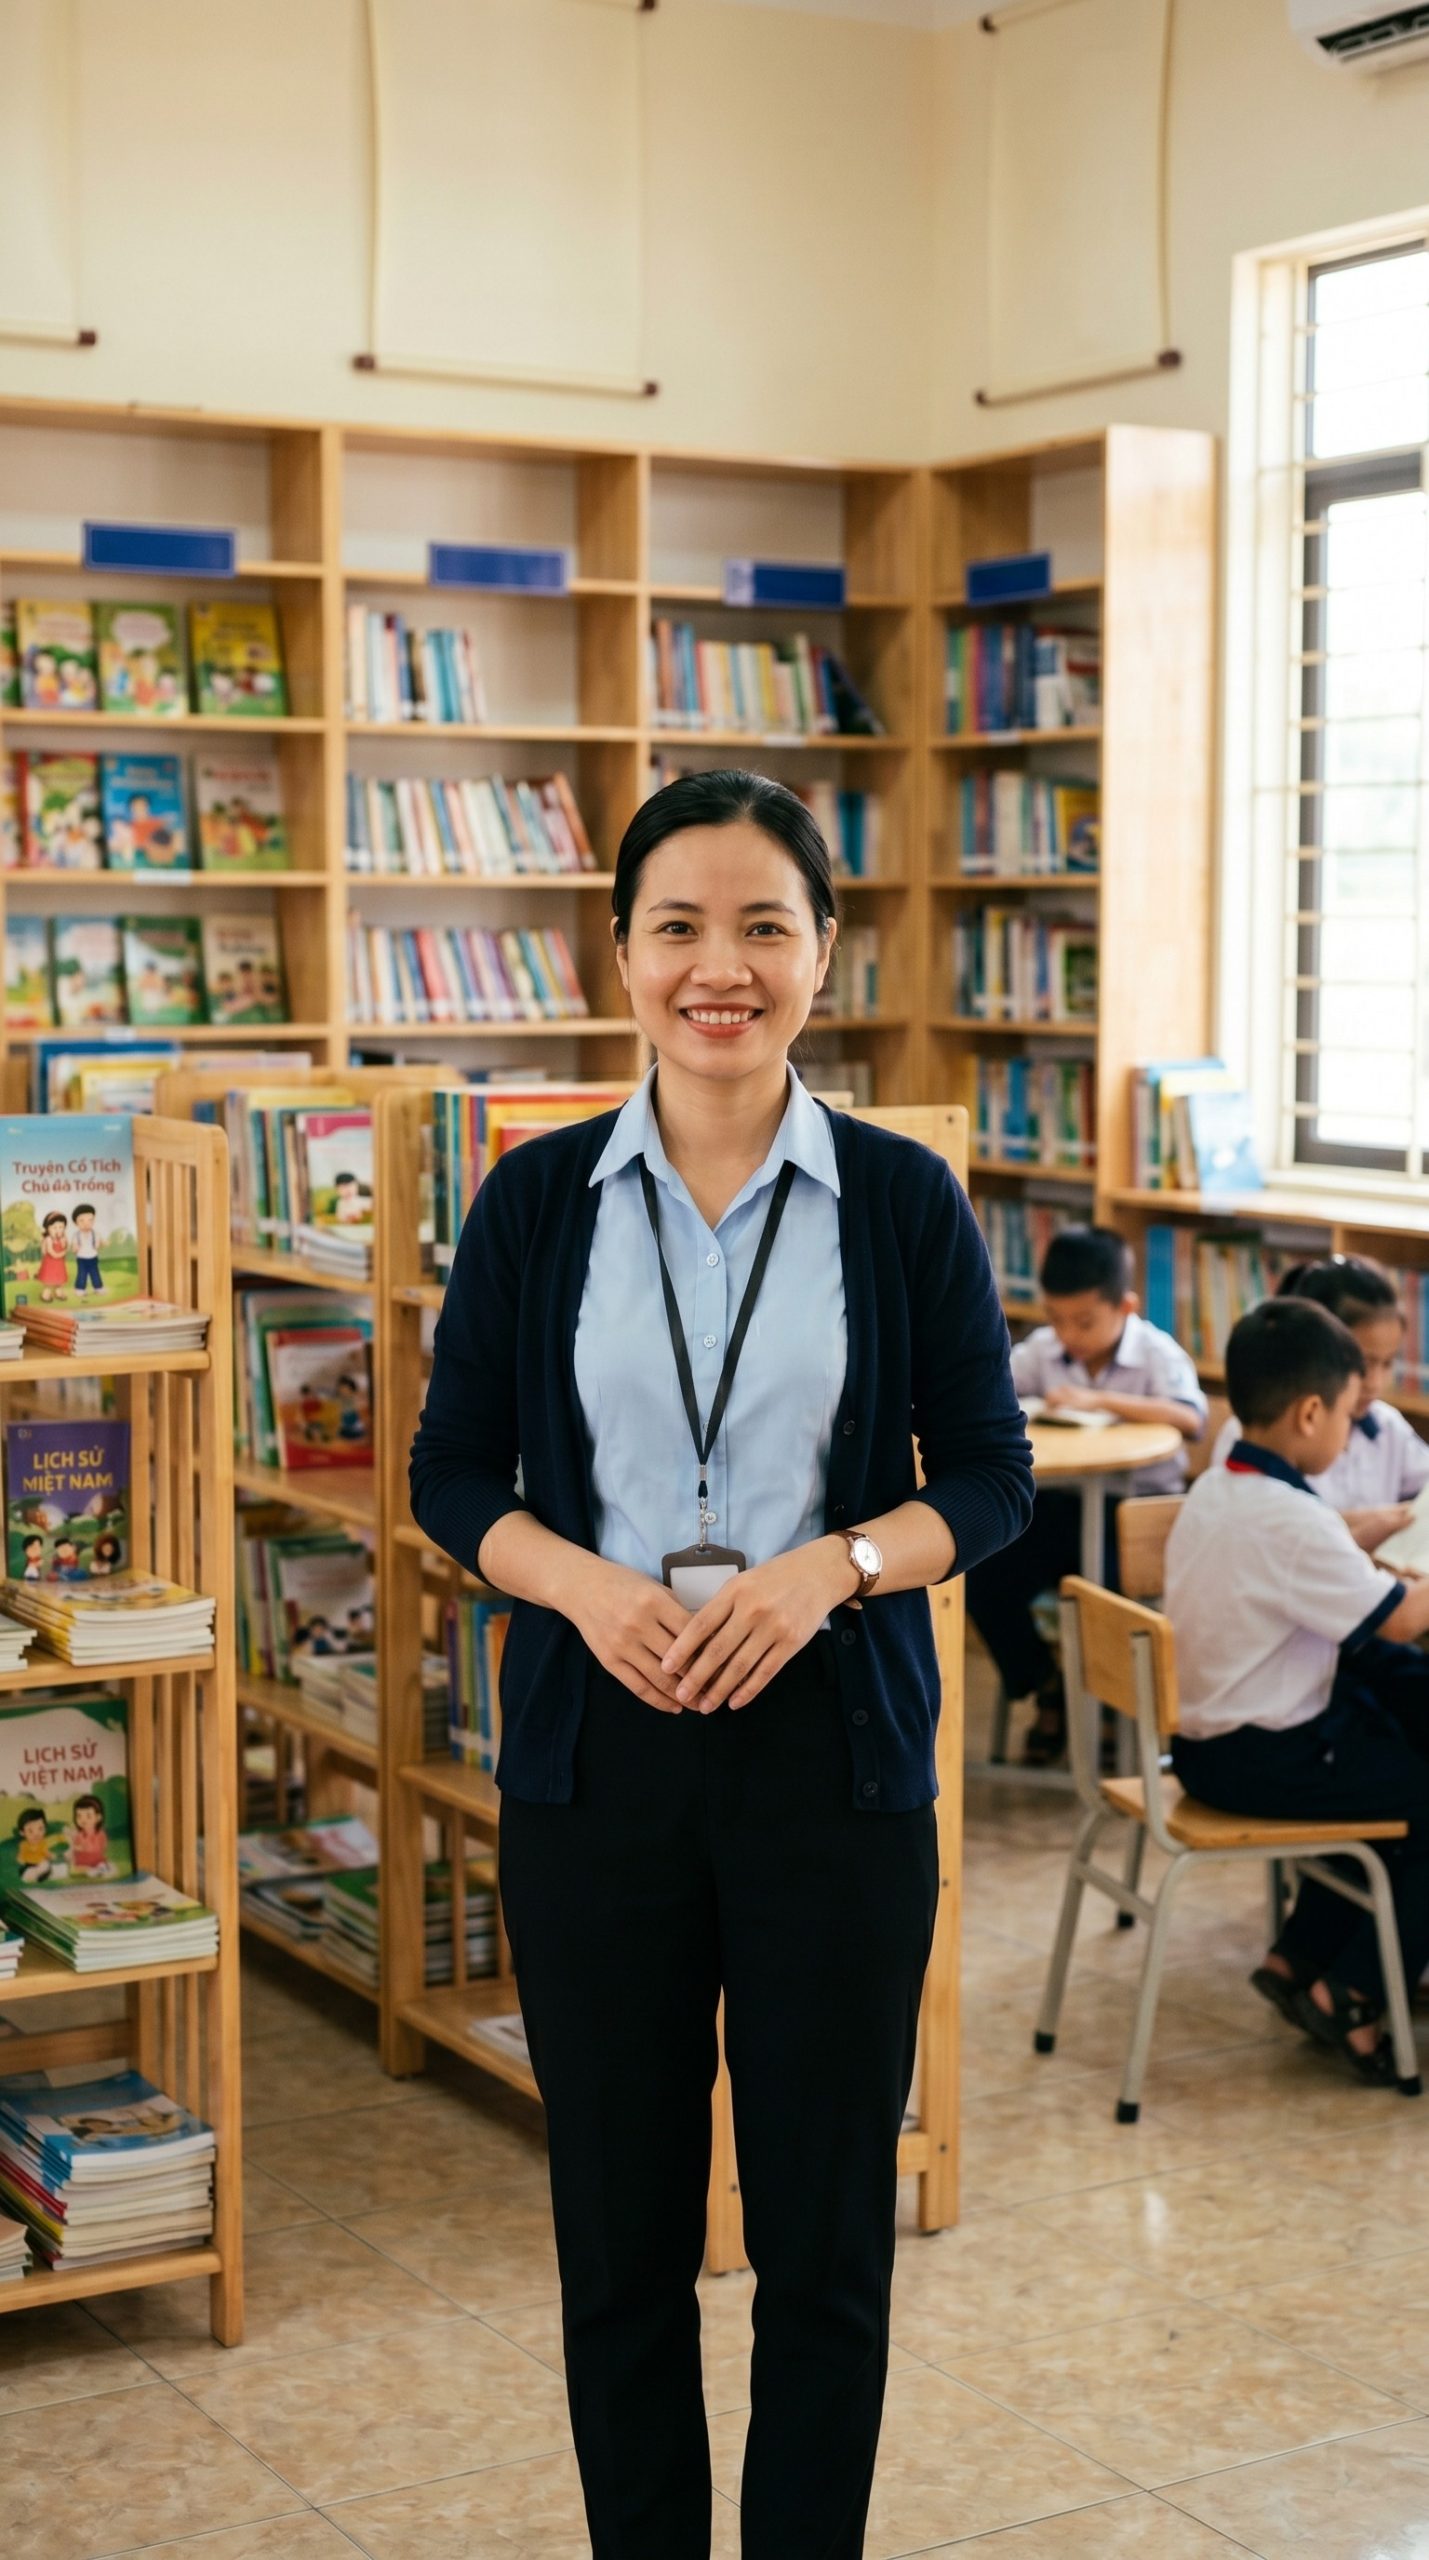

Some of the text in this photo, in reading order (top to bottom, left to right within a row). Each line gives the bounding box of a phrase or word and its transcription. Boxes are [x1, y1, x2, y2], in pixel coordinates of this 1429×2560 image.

[12, 1160, 64, 1177] Truyện
[33, 1444, 105, 1471] LỊCH SỬ
[69, 1473, 113, 1491] NAM
[23, 1737, 98, 1766] LỊCH SỬ
[19, 1765, 104, 1790] VIỆT NAM
